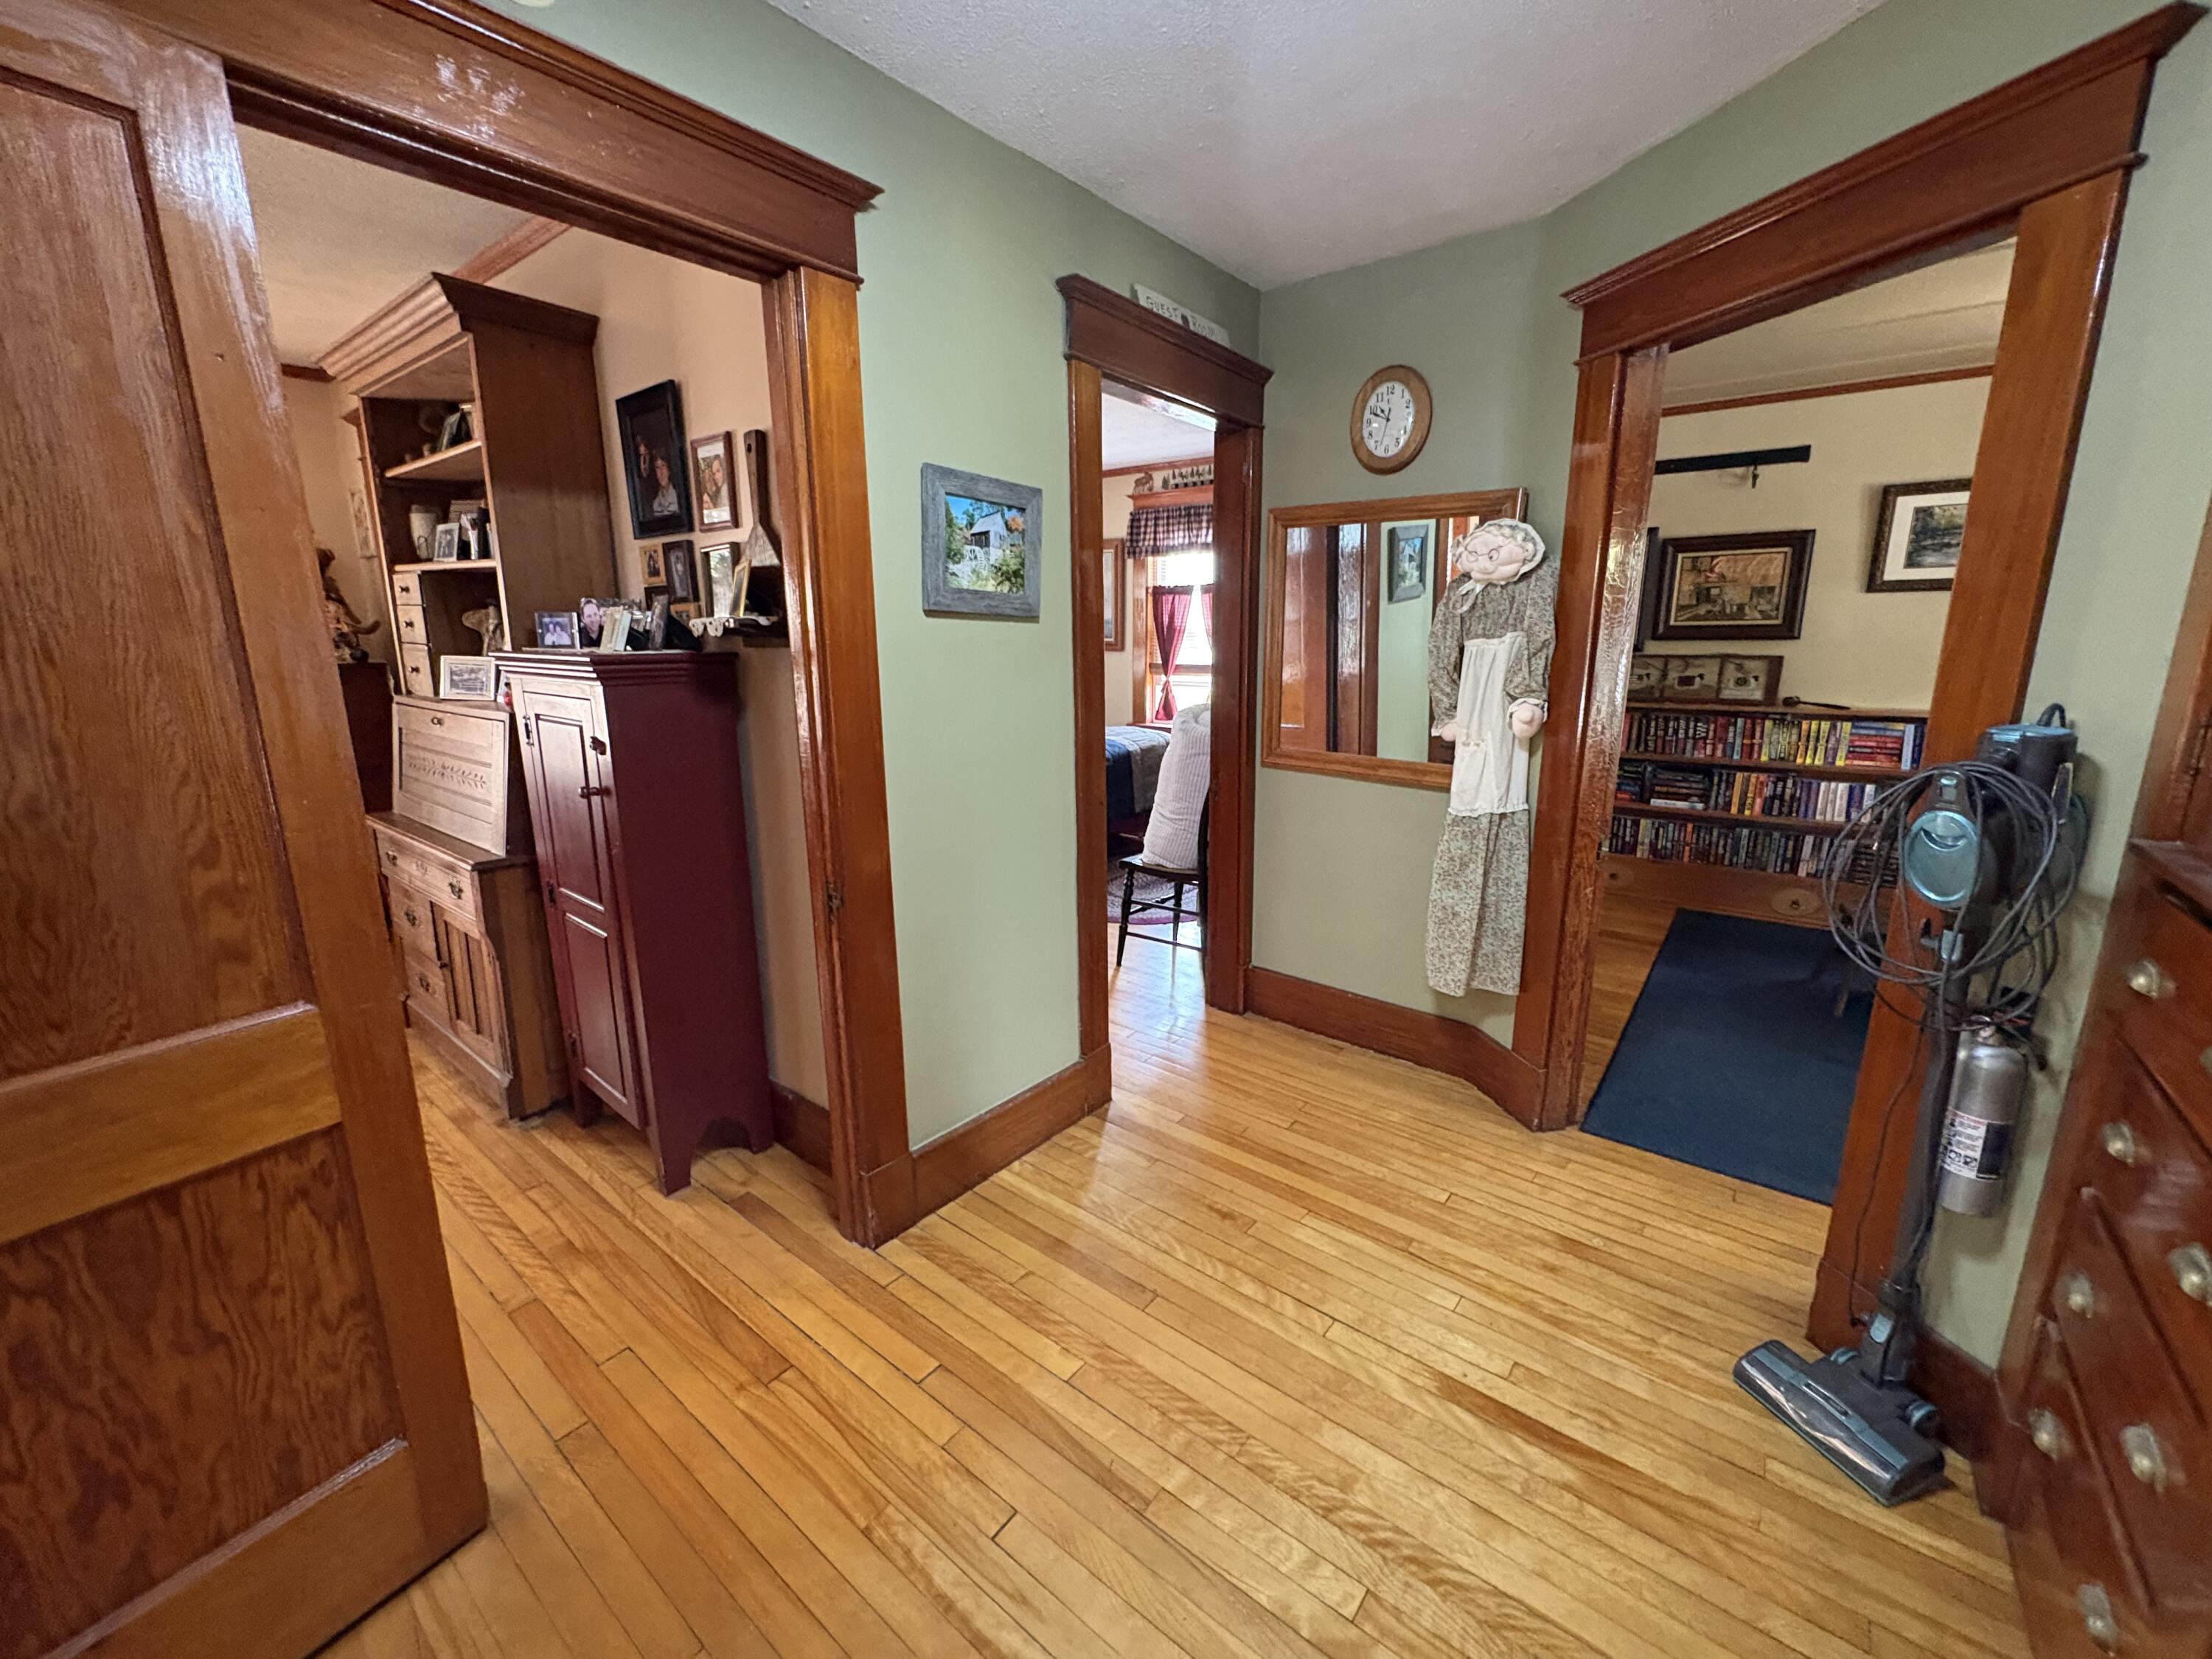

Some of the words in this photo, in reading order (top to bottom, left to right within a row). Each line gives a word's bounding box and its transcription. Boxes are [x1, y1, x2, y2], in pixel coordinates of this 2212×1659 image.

[1146, 295, 1178, 319] GUEST
[1385, 384, 1396, 395] 12
[1401, 389, 1405, 399] 1
[1376, 392, 1384, 403] 11
[1369, 404, 1378, 415] 10
[1405, 399, 1411, 409] 2
[1366, 418, 1372, 428] 9
[1368, 431, 1373, 439] 8
[1374, 440, 1379, 451] 7
[1394, 437, 1400, 448] 5
[1384, 444, 1389, 455] 6
